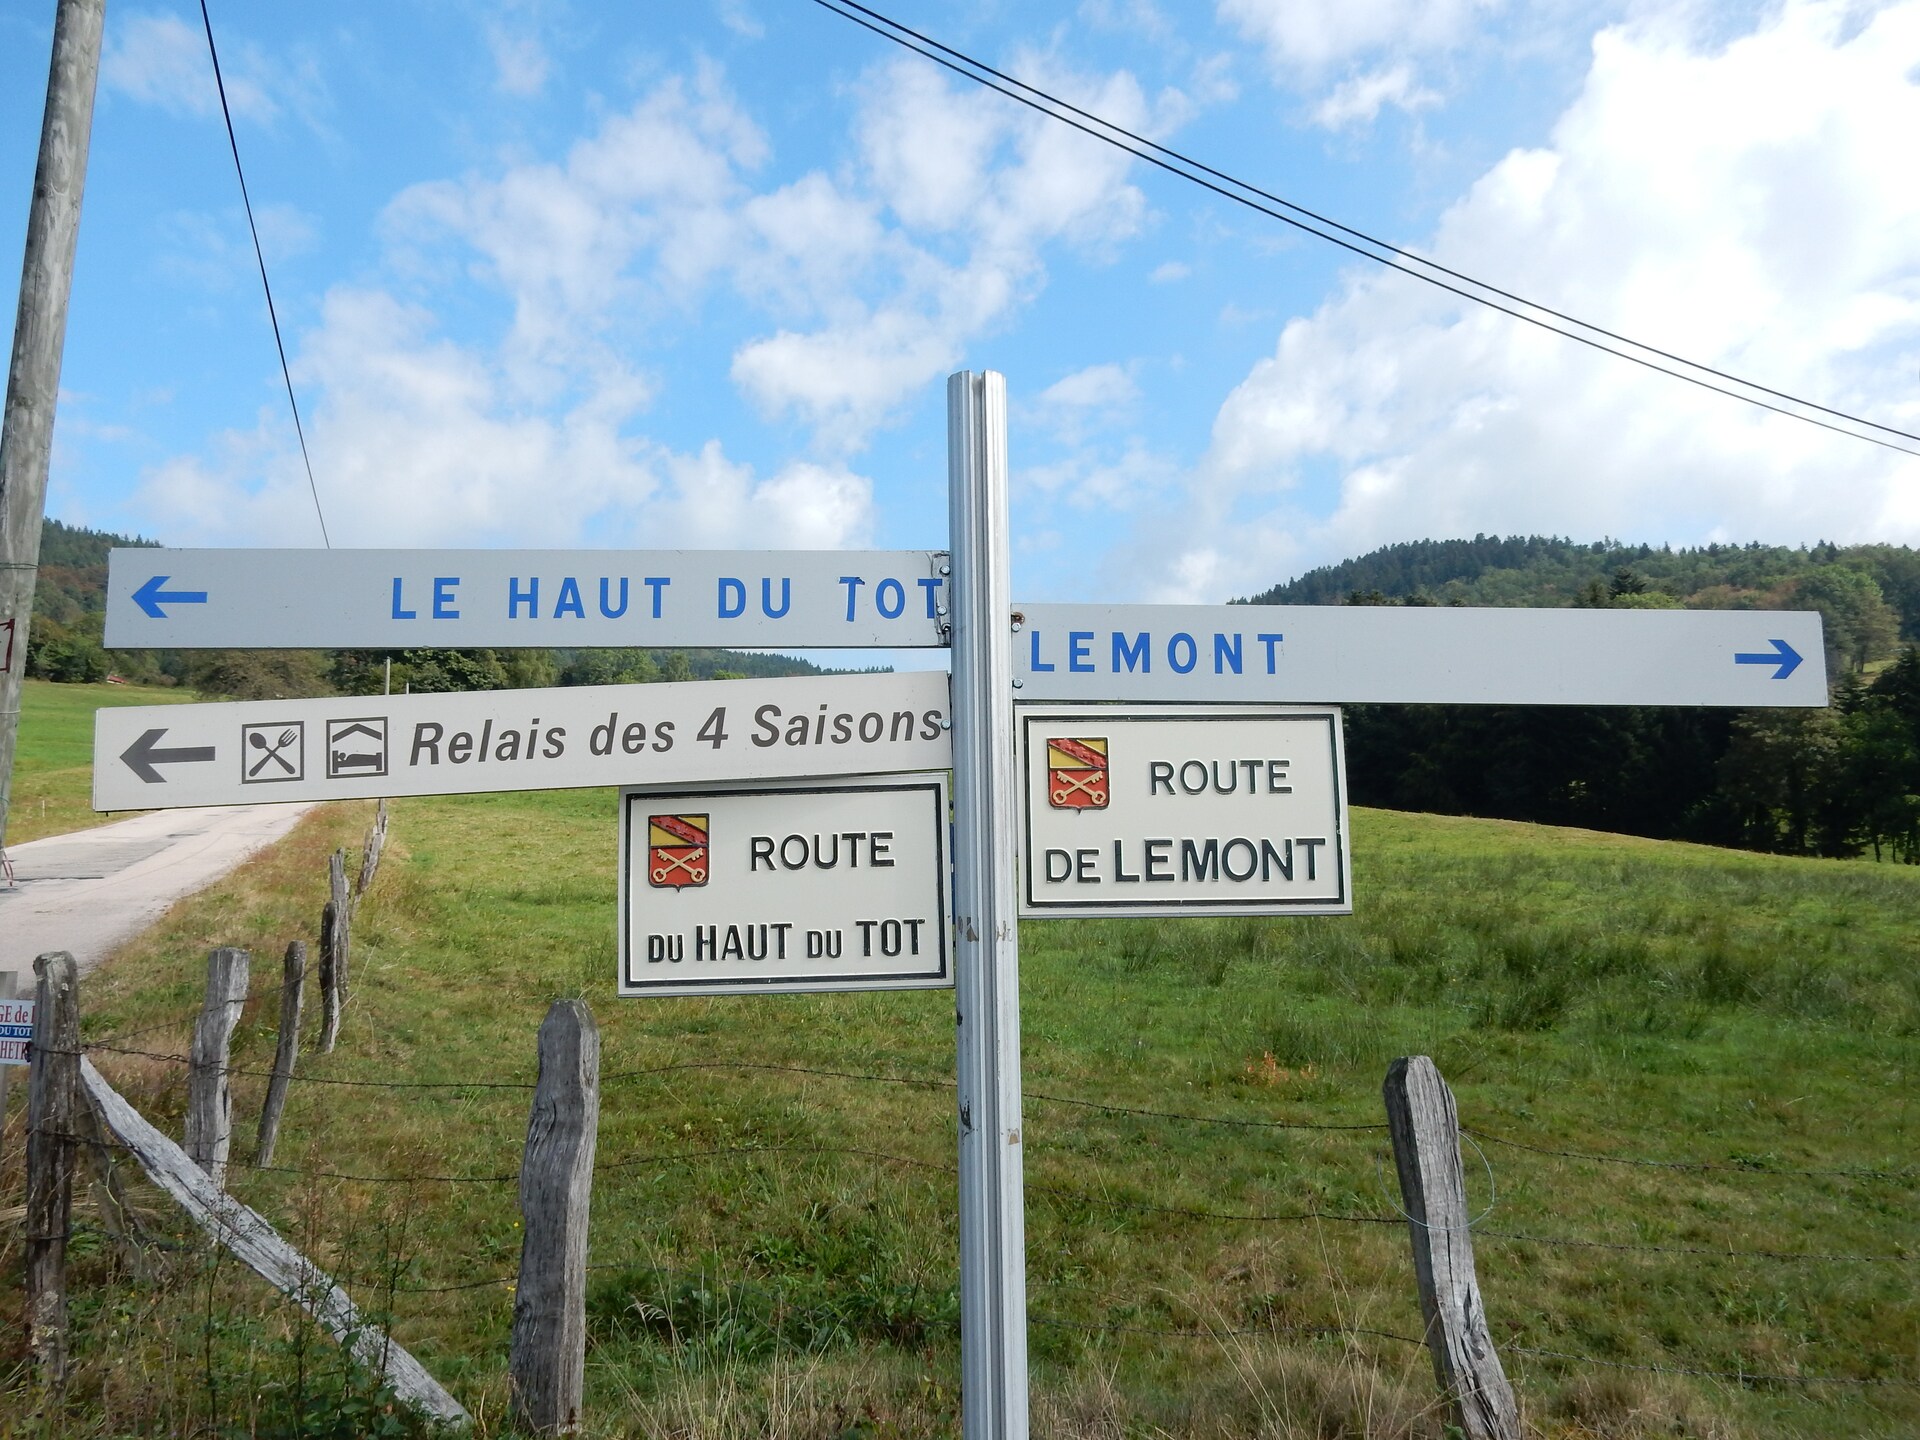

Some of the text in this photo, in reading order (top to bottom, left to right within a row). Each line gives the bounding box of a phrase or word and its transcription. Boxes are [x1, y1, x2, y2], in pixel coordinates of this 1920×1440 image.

[391, 576, 943, 622] LE HAUT DU TOT
[1031, 631, 1283, 674] LEMONT
[409, 702, 942, 766] Relais des 4 Saisons
[1150, 760, 1293, 796] ROUTE
[751, 831, 896, 872] ROUTE
[1046, 837, 1326, 883] DE LEMONT
[648, 918, 926, 963] DU HAUT DU TOT
[13, 1027, 32, 1036] TOT
[15, 1005, 29, 1023] de
